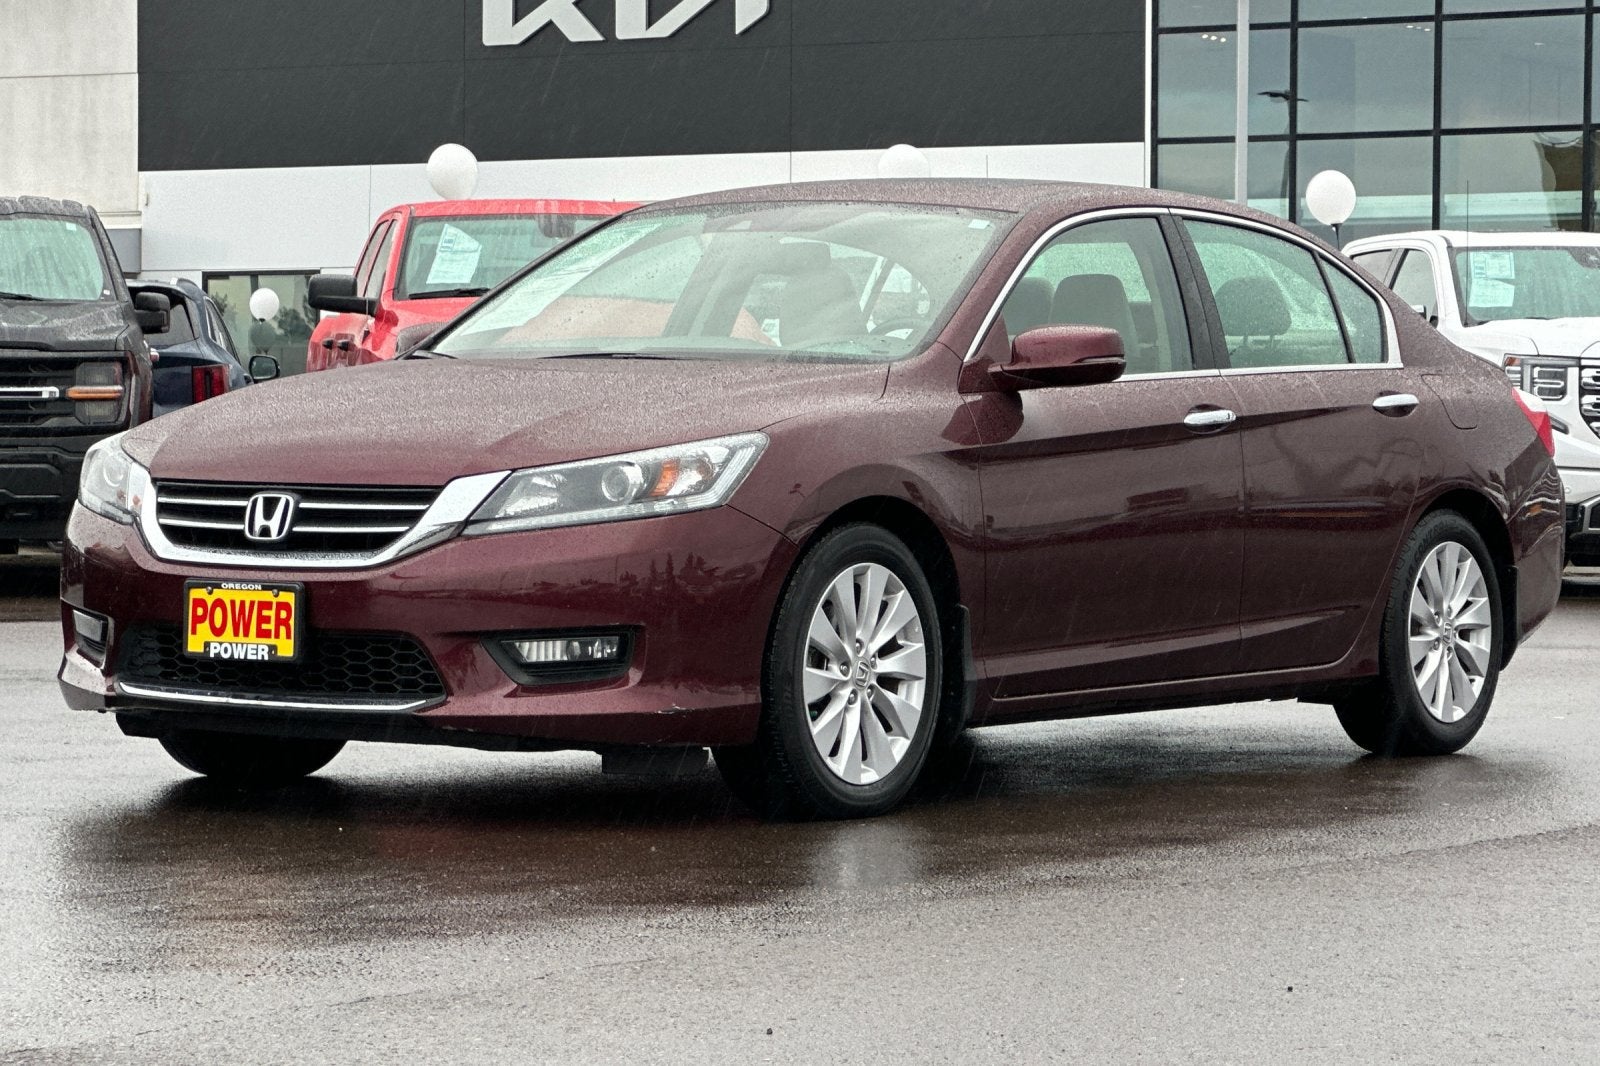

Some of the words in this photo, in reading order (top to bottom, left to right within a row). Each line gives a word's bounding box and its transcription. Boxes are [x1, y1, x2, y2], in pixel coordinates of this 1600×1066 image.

[221, 582, 262, 591] OREGON
[190, 597, 293, 640] POWER
[209, 642, 269, 660] POWER
